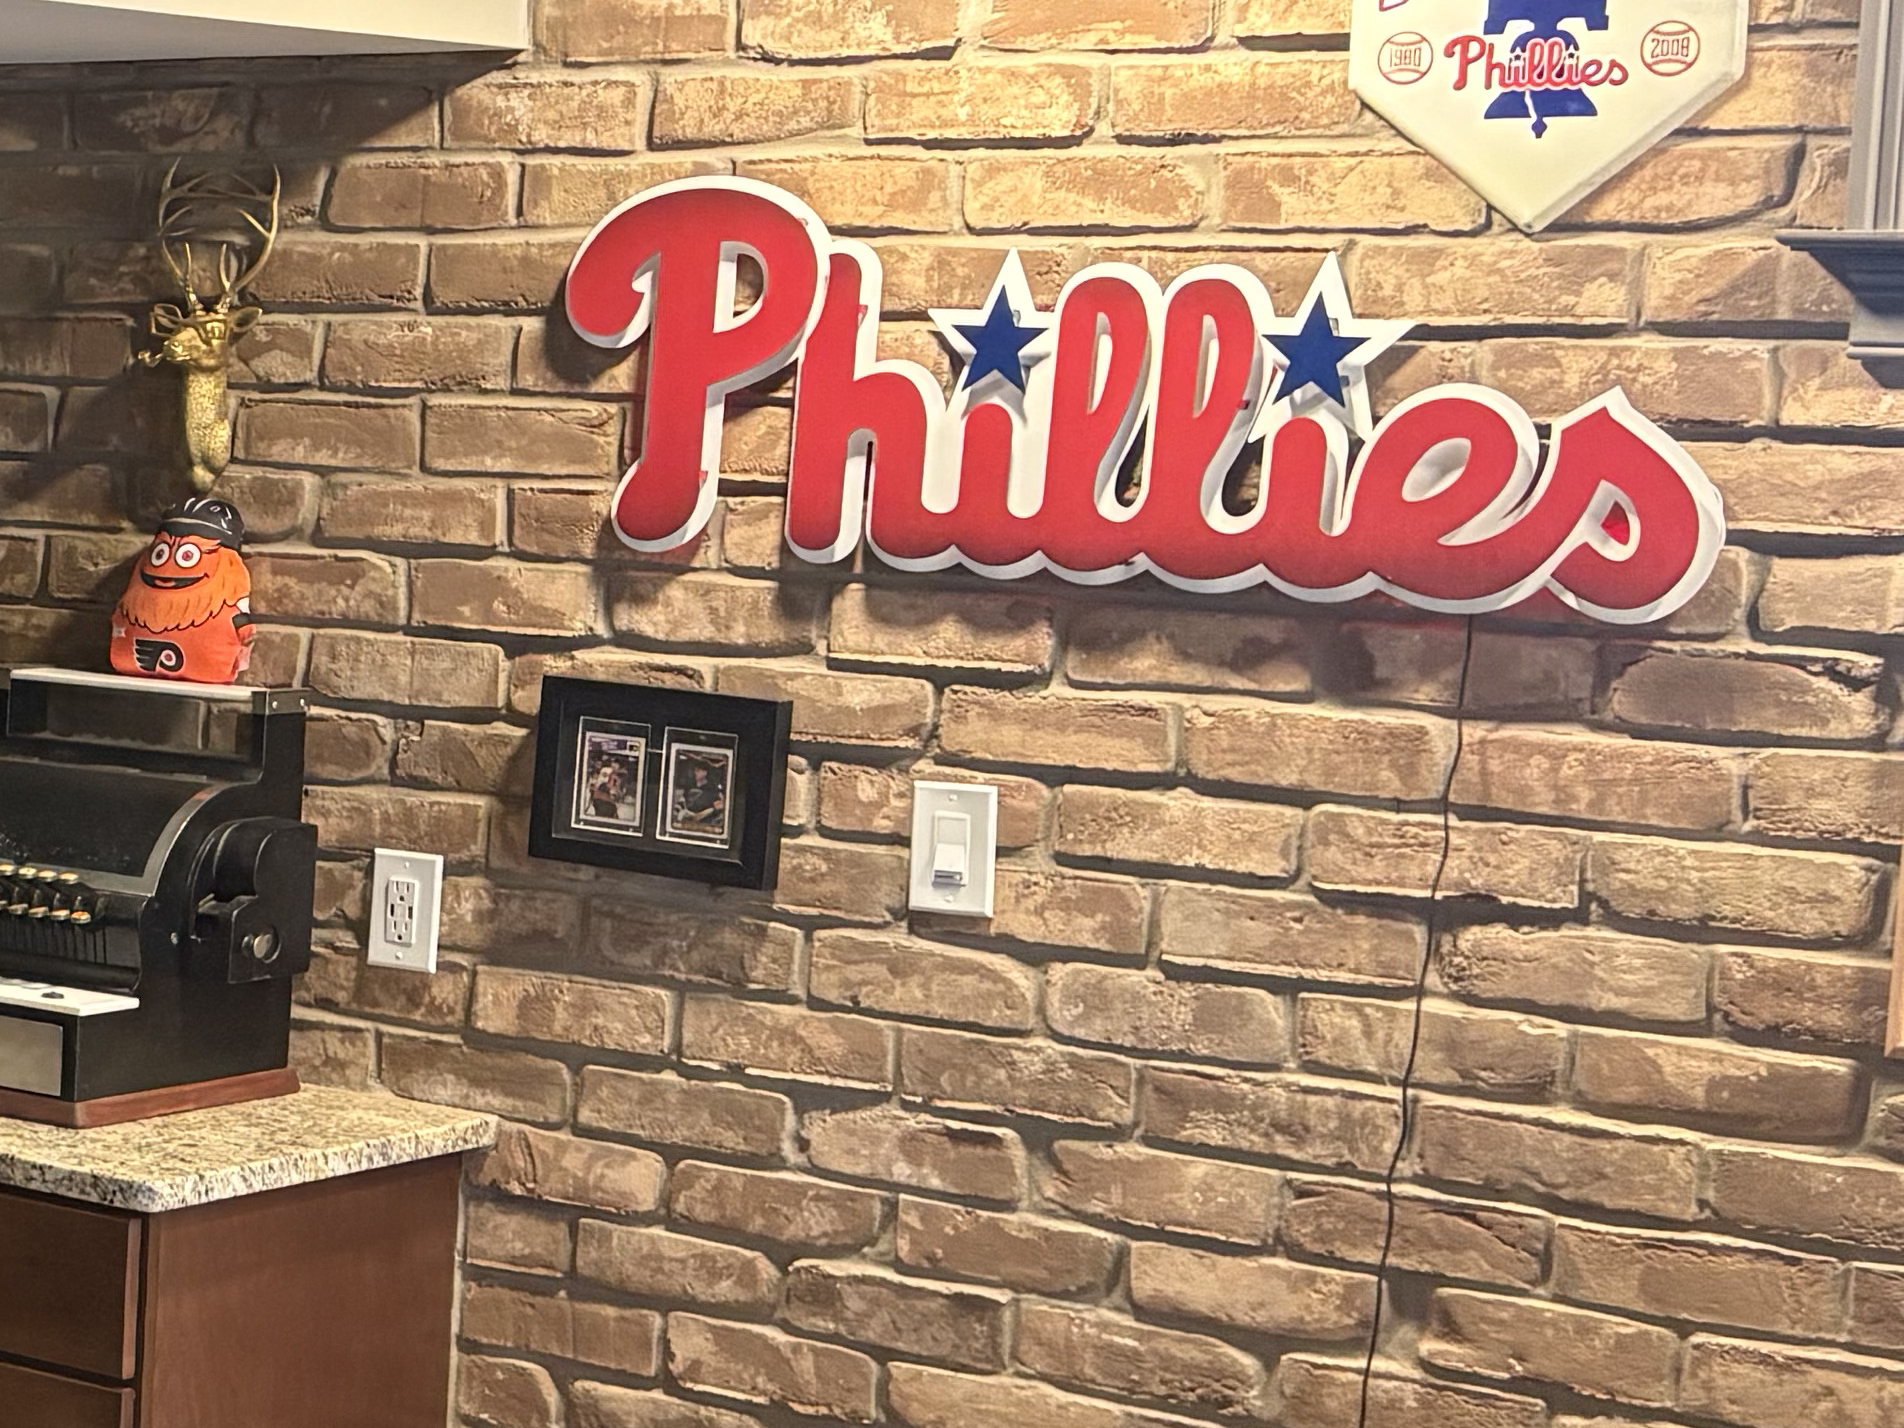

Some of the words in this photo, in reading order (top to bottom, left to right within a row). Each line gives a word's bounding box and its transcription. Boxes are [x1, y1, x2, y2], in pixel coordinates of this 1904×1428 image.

[1388, 47, 1422, 69] 1980
[1443, 34, 1629, 92] Phillies
[1650, 38, 1690, 60] 2008
[565, 175, 1726, 625] Phillies
